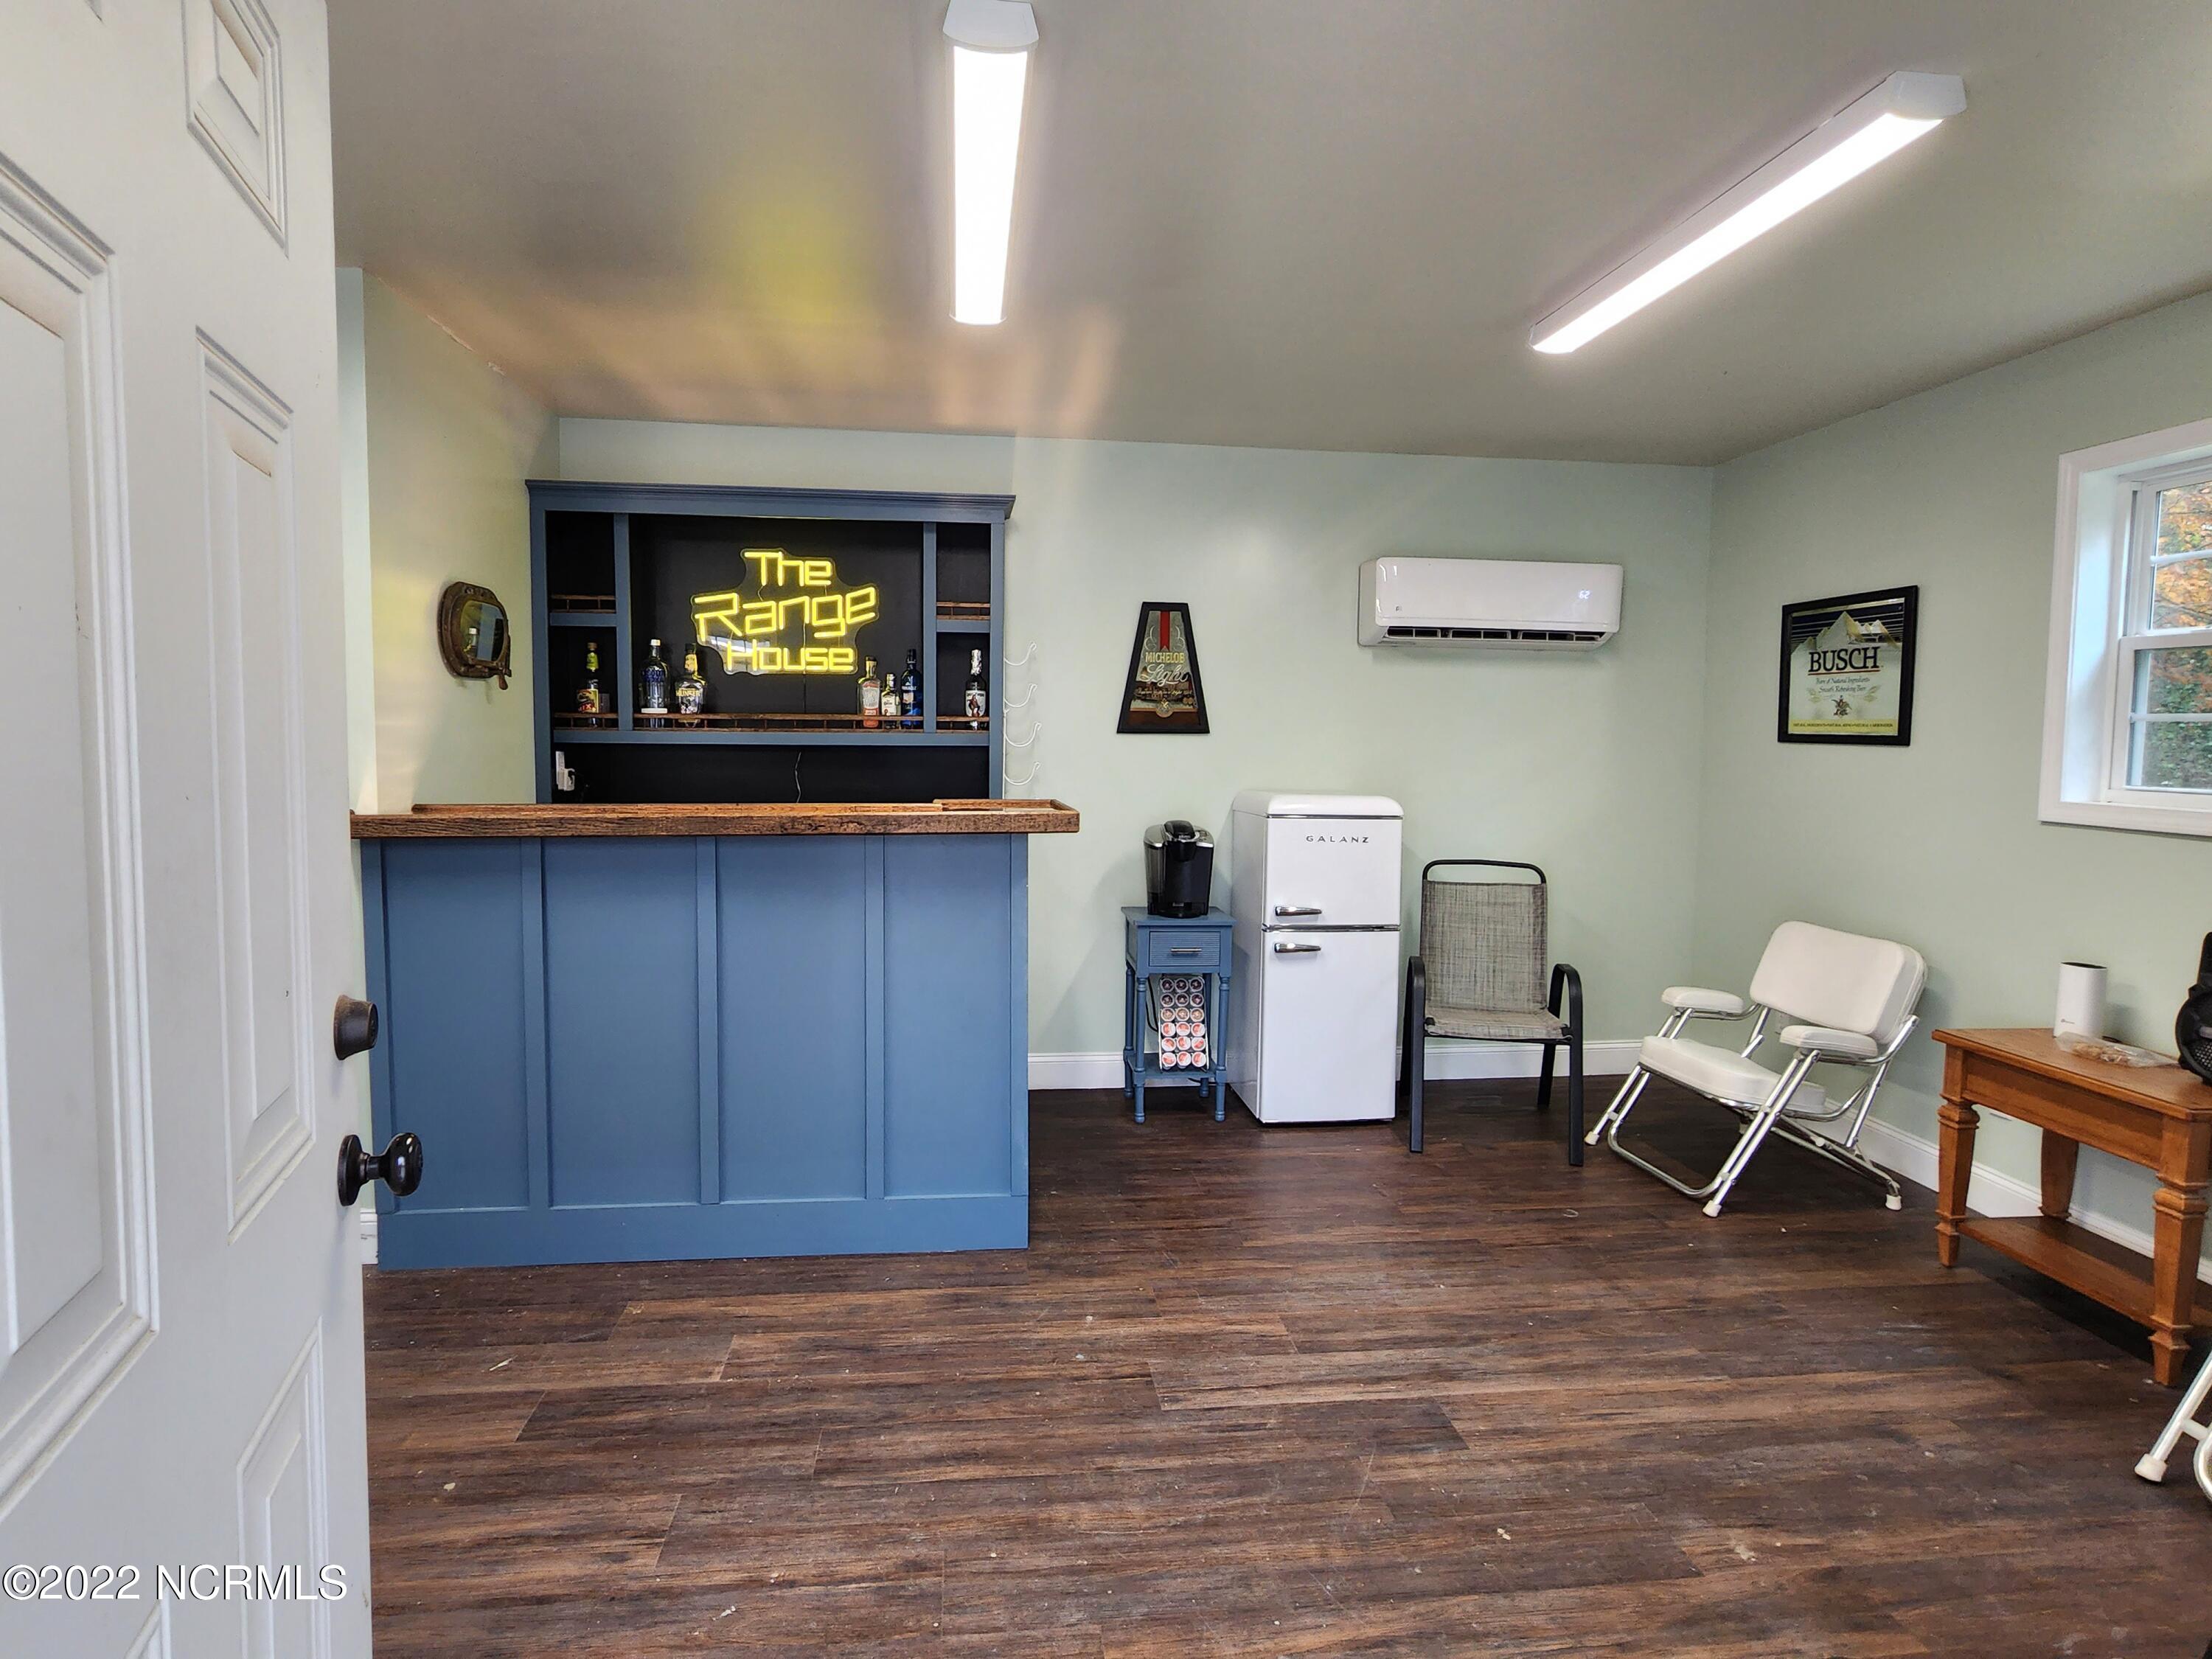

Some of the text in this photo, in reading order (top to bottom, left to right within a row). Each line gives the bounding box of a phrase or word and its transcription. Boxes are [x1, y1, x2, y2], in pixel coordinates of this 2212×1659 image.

[744, 551, 832, 586] The
[695, 587, 876, 641] Range
[727, 639, 854, 671] House
[1145, 652, 1186, 664] MICHELOB
[1808, 646, 1881, 672] BUSCH
[1140, 664, 1189, 686] Light
[1305, 835, 1369, 844] GALANZ
